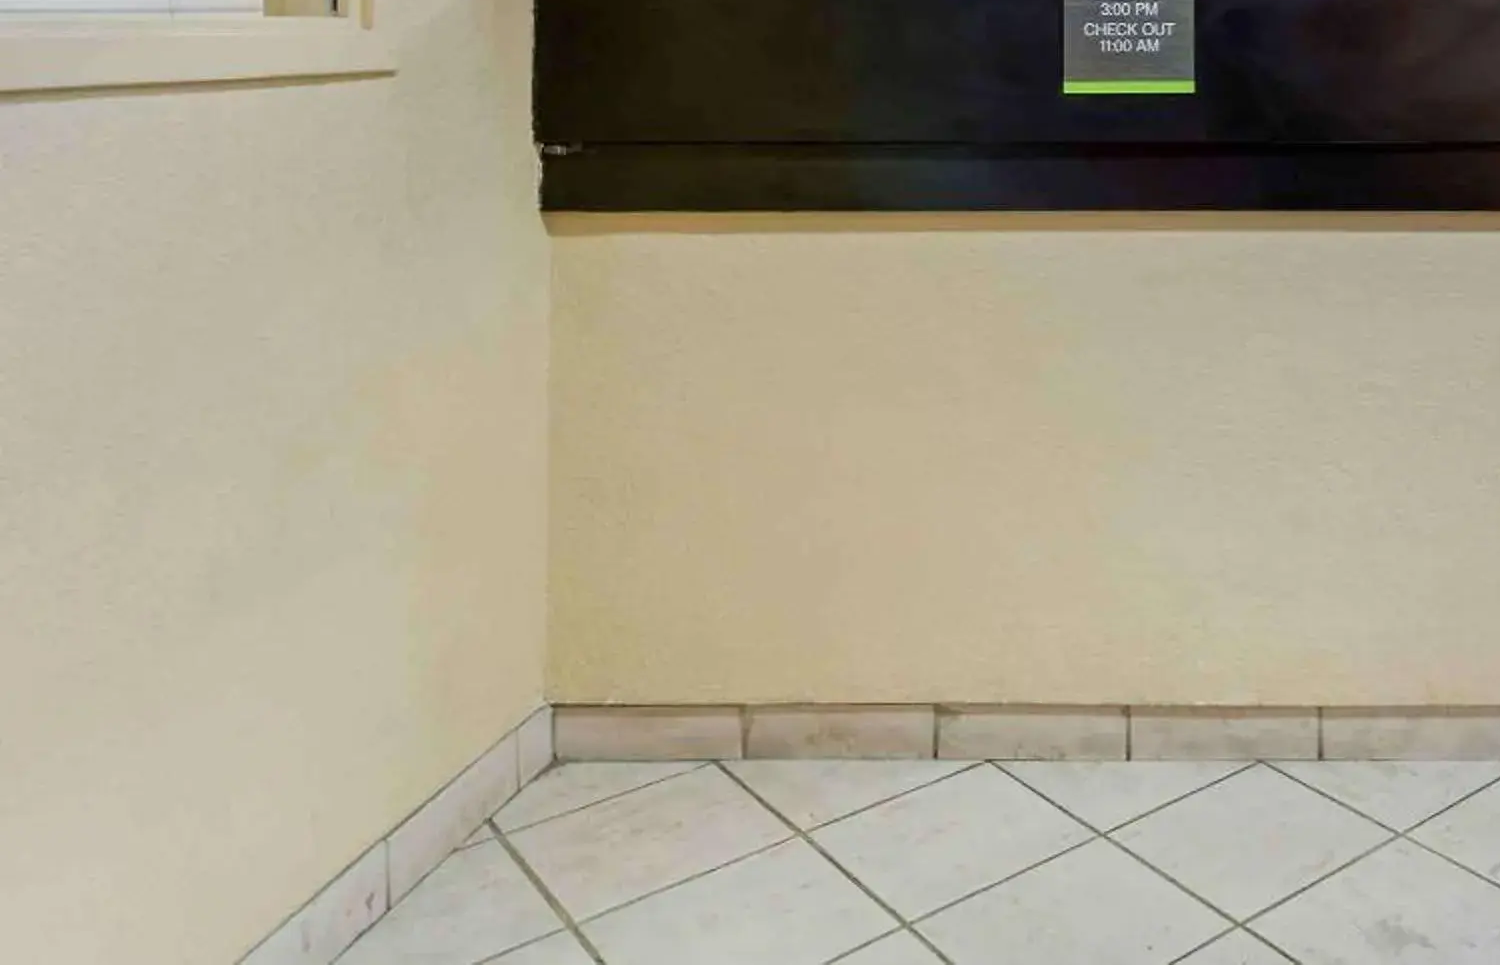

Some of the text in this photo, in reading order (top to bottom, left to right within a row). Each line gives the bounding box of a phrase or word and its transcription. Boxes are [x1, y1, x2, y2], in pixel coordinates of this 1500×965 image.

[1100, 2, 1158, 16] 3:00 PM
[1083, 22, 1176, 36] CHECK OUT
[1100, 38, 1160, 52] 11:00 AM
